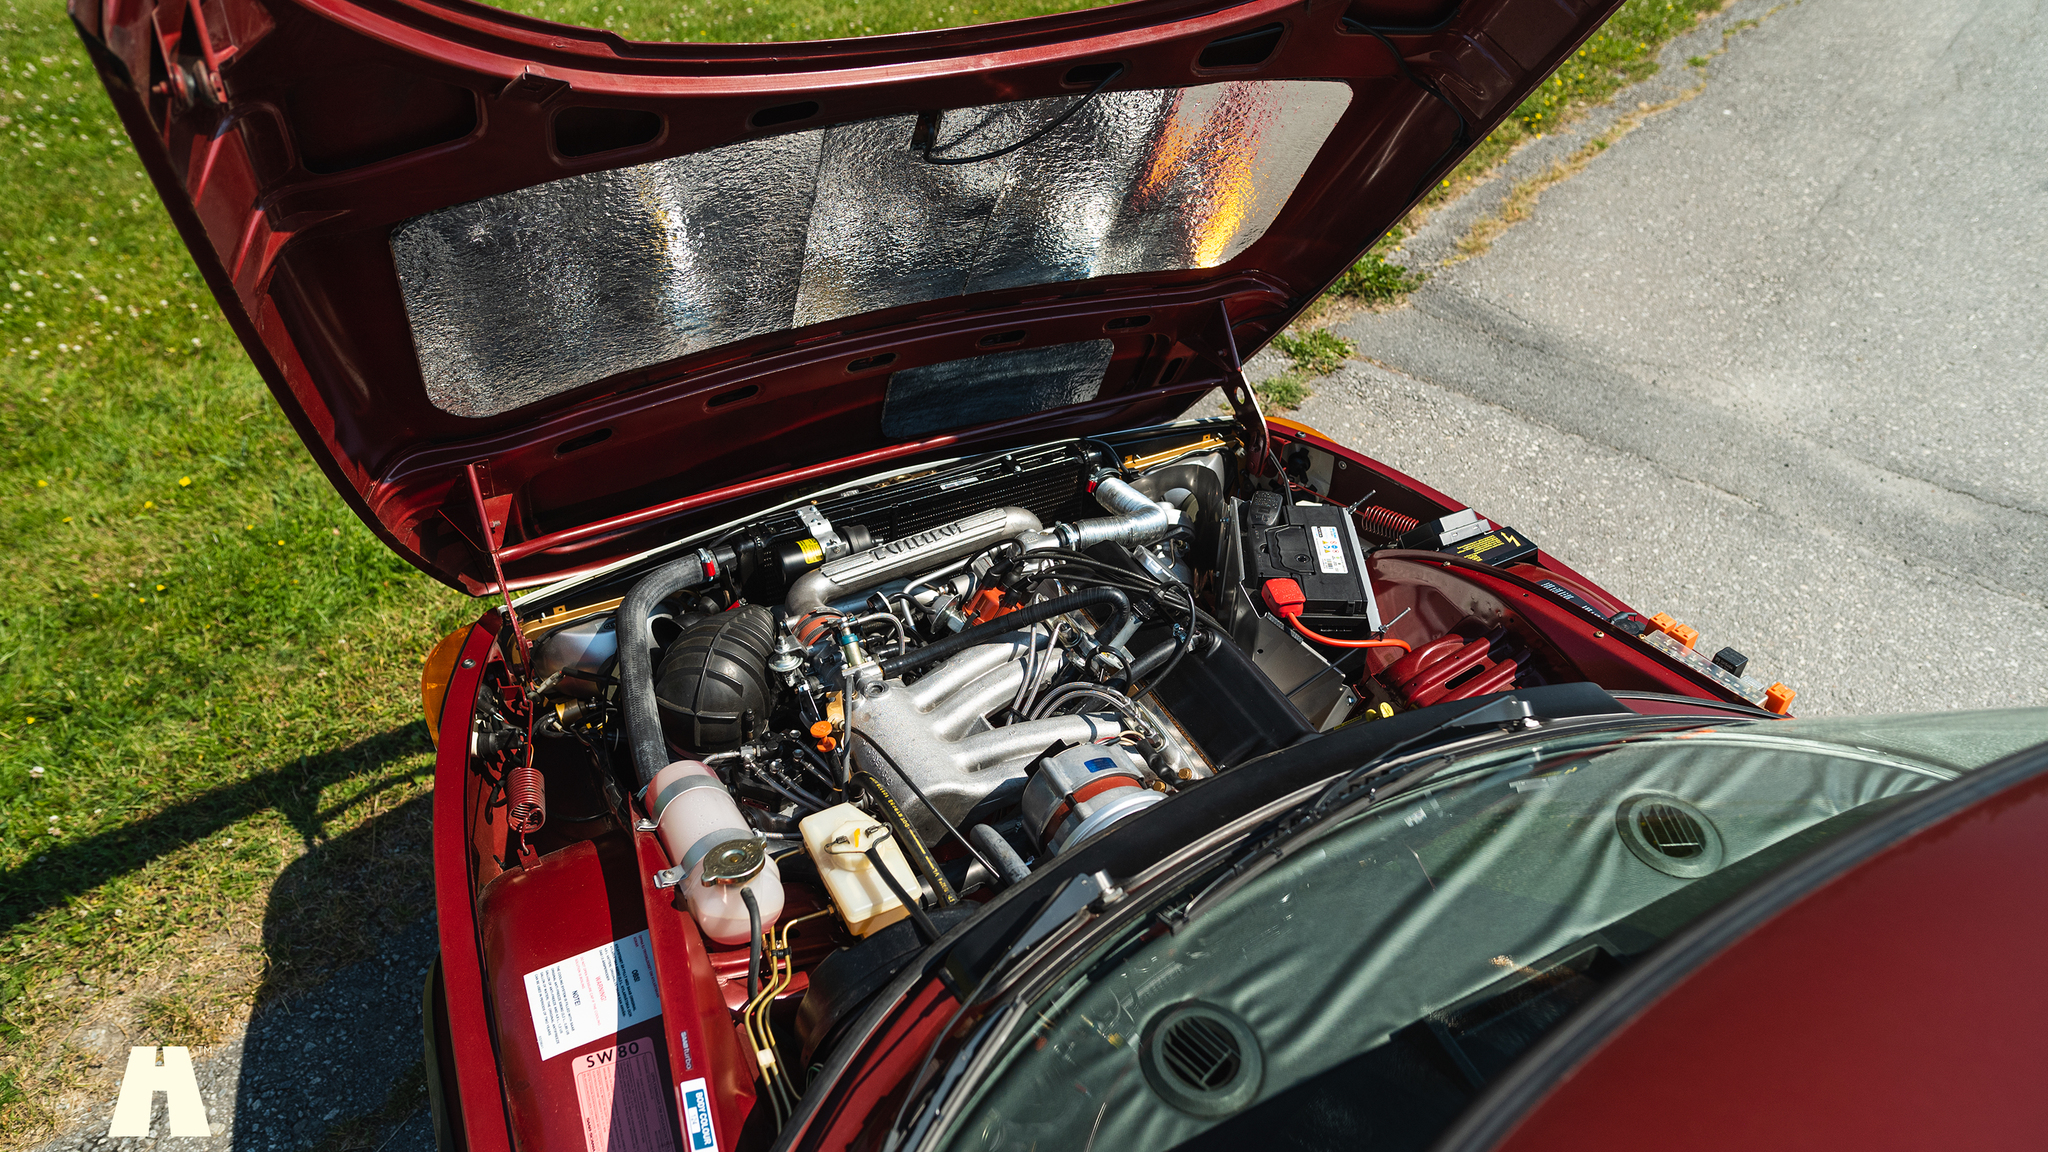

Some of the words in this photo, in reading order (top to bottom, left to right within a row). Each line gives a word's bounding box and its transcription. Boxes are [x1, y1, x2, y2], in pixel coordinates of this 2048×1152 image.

[632, 969, 641, 983] OBS!
[572, 990, 581, 1007] NOTE!
[594, 976, 607, 1003] WARNING!
[695, 1091, 706, 1113] BODY
[699, 1113, 712, 1146] COLOUR
